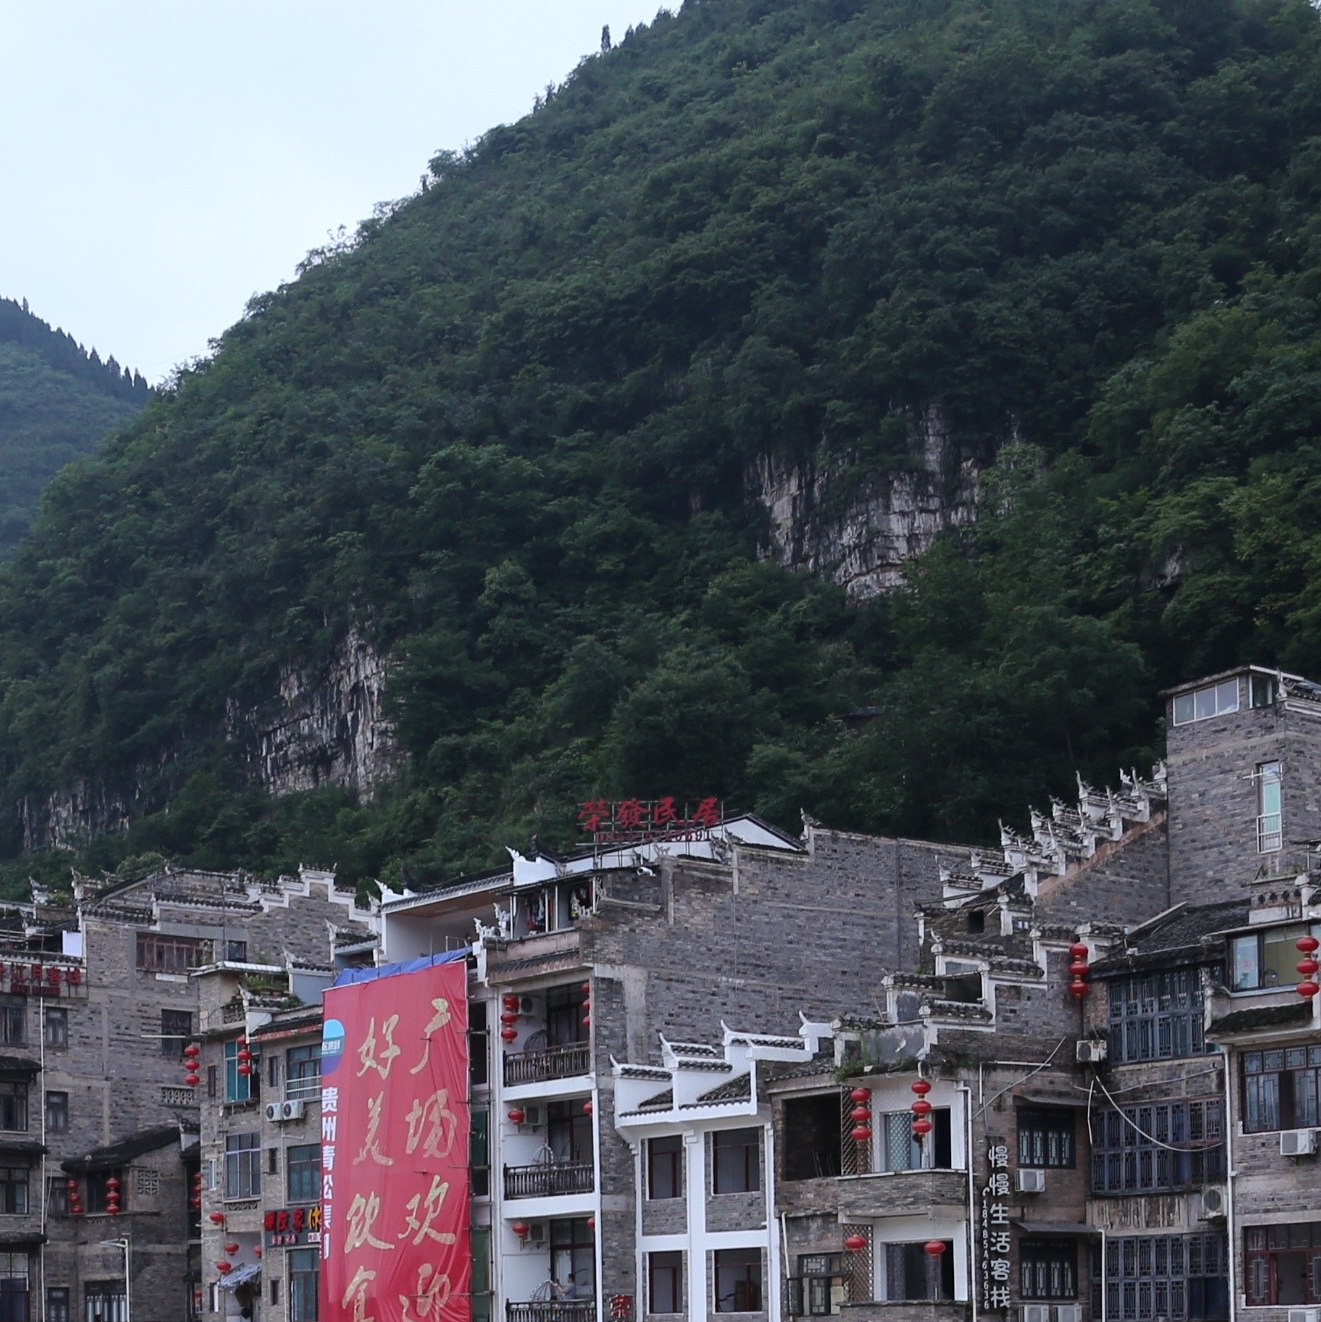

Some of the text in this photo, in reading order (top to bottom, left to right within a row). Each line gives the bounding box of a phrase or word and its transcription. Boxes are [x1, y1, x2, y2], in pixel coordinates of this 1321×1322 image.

[988, 1145, 1010, 1309] 慢慢生活客栈
